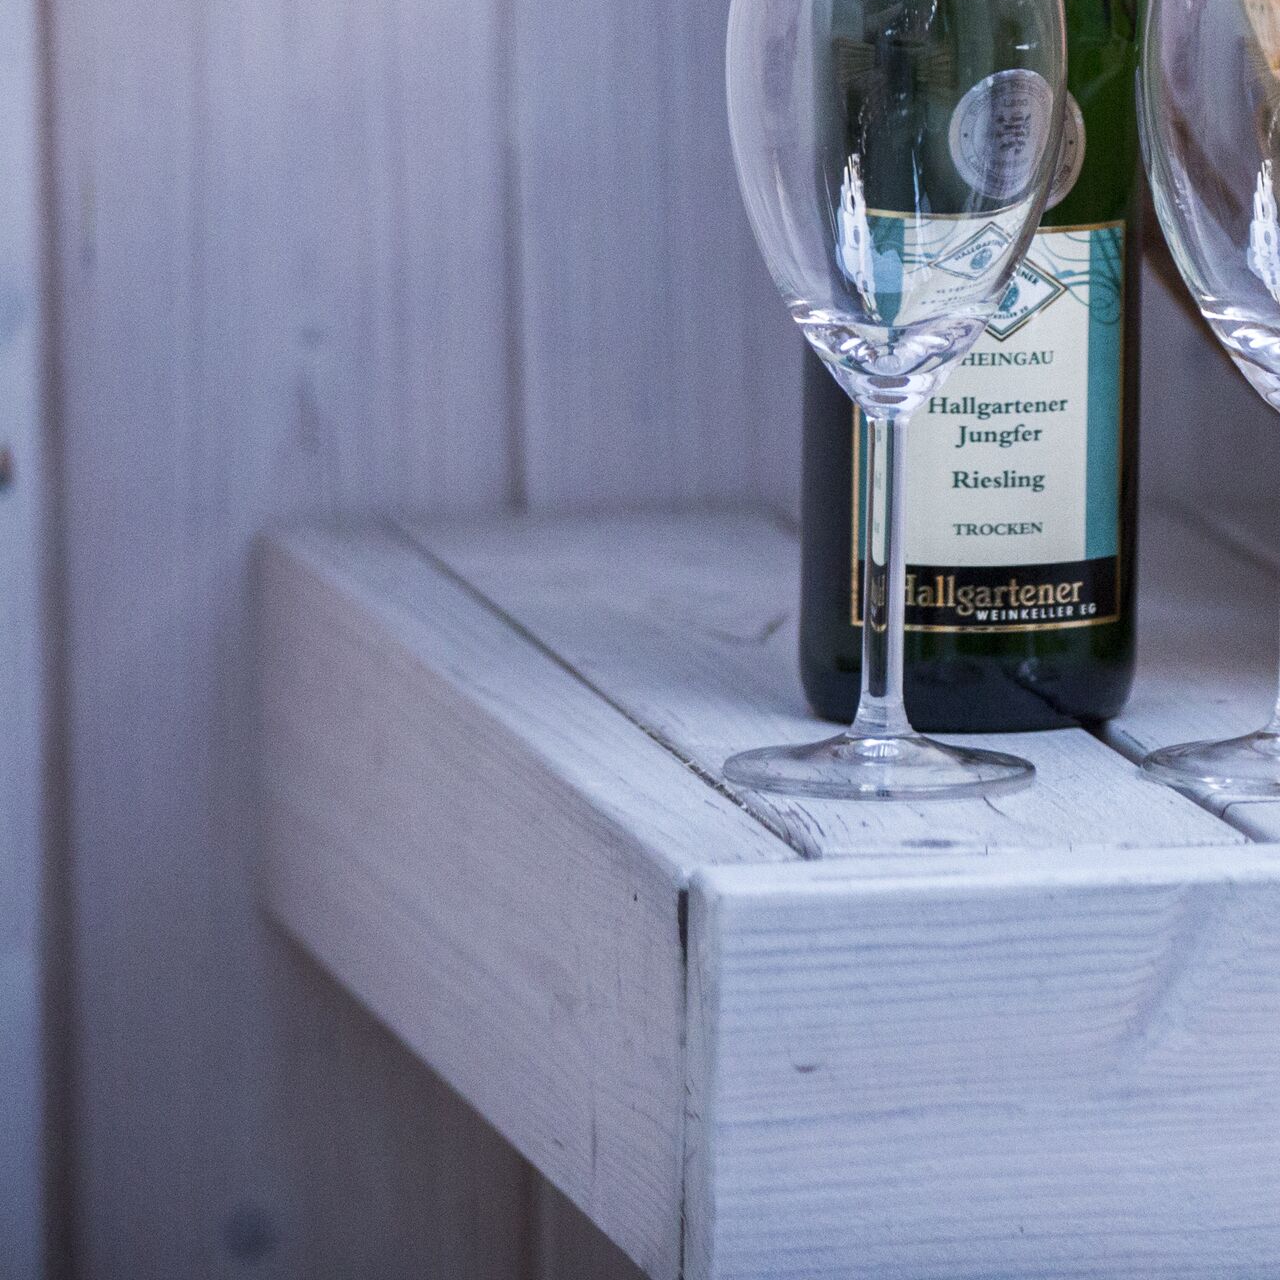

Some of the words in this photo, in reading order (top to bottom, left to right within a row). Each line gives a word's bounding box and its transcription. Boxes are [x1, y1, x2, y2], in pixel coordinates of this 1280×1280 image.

[960, 350, 1055, 367] HEINGAU
[928, 396, 1068, 420] Hallgartener
[955, 424, 1042, 448] Jungfer
[951, 470, 1045, 493] Riesling
[952, 522, 1043, 536] TROCKEN
[975, 606, 1073, 621] WEINKELLER
[1080, 603, 1097, 615] EG
